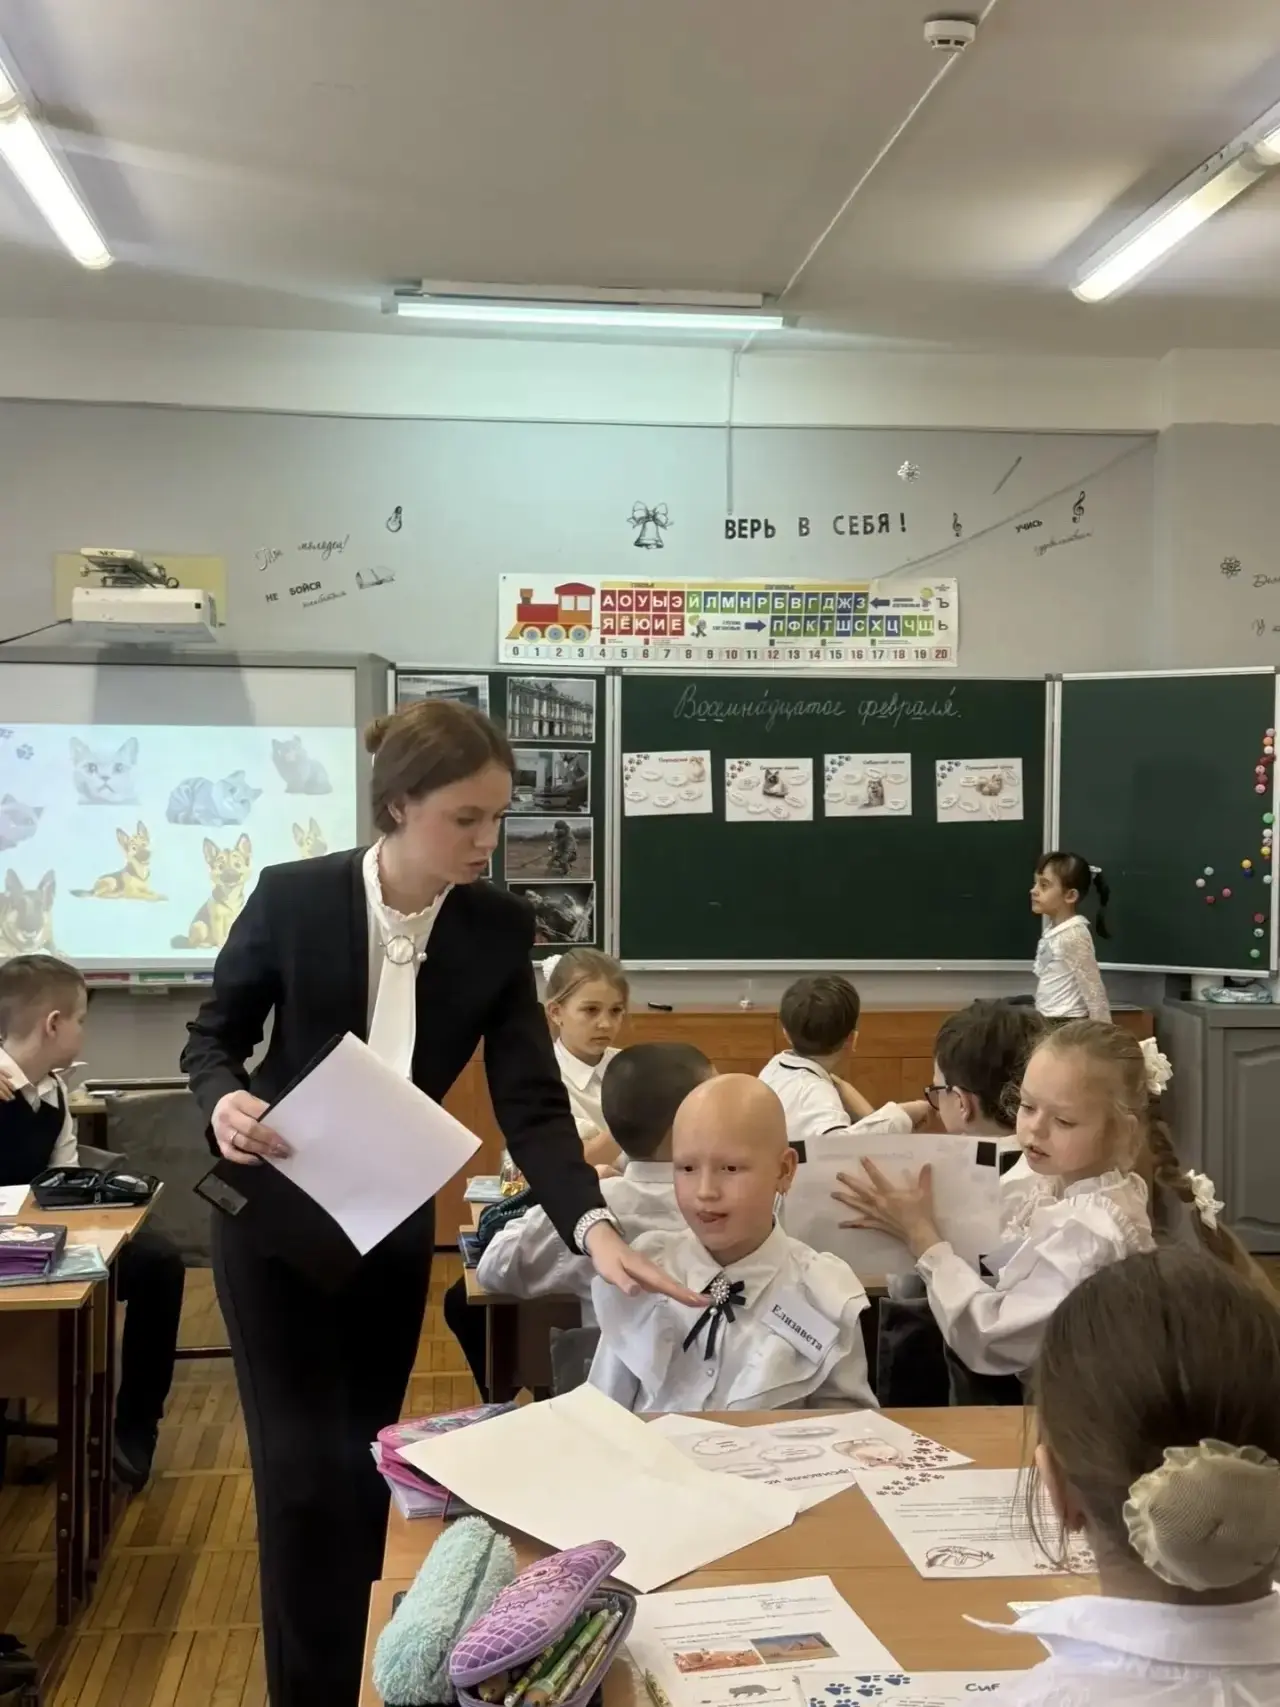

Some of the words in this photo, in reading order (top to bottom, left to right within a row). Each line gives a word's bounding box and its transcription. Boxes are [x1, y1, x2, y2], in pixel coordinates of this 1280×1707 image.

[724, 518, 777, 540] ВЕРЬ
[798, 516, 811, 537] В
[1015, 519, 1043, 533] УЧИСЬ
[264, 592, 279, 602] НЕ
[289, 581, 322, 596] БОЙСЯ
[602, 595, 615, 607] А
[620, 595, 632, 607] О
[637, 595, 648, 607] У
[653, 595, 668, 607] Ы
[671, 595, 682, 607] Э
[689, 594, 700, 609] Й
[705, 596, 717, 609] Л
[722, 596, 735, 609] М
[740, 597, 750, 609] Н
[758, 597, 768, 609] Р
[774, 597, 785, 609] Б
[791, 597, 802, 609] В
[808, 597, 818, 609] Г
[822, 597, 834, 610] Д
[838, 597, 852, 609] Ж
[856, 597, 866, 609] З
[602, 618, 614, 630] Я
[620, 615, 632, 630] Ё
[635, 618, 651, 630] Ю
[654, 618, 666, 630] И
[671, 618, 682, 630] Е
[773, 620, 783, 631] П
[788, 619, 801, 631] Ф
[806, 620, 817, 631] К
[822, 620, 833, 631] Т
[836, 620, 851, 631] Ш
[855, 620, 865, 631] С
[871, 620, 883, 631] Х
[887, 620, 898, 634] Ц
[904, 620, 915, 631] Ч
[919, 620, 934, 635] Щ
[512, 647, 519, 656] 0
[534, 647, 540, 657] 1
[556, 647, 563, 657] 2
[577, 648, 584, 658] 3
[599, 648, 606, 658] 4
[620, 648, 628, 658] 5
[642, 648, 650, 658] 6
[663, 648, 671, 658] 7
[685, 649, 692, 659] 8
[707, 649, 714, 659] 9
[725, 650, 738, 659] 10
[746, 650, 758, 659] 11
[767, 650, 779, 659] 12
[788, 650, 801, 659] 13
[810, 650, 821, 659] 14
[829, 650, 842, 659] 15
[851, 650, 864, 659] 16
[872, 650, 884, 659] 17
[892, 650, 905, 659] 18
[914, 650, 927, 659] 19
[935, 650, 948, 659] 20
[772, 1304, 823, 1351] Елизавета
